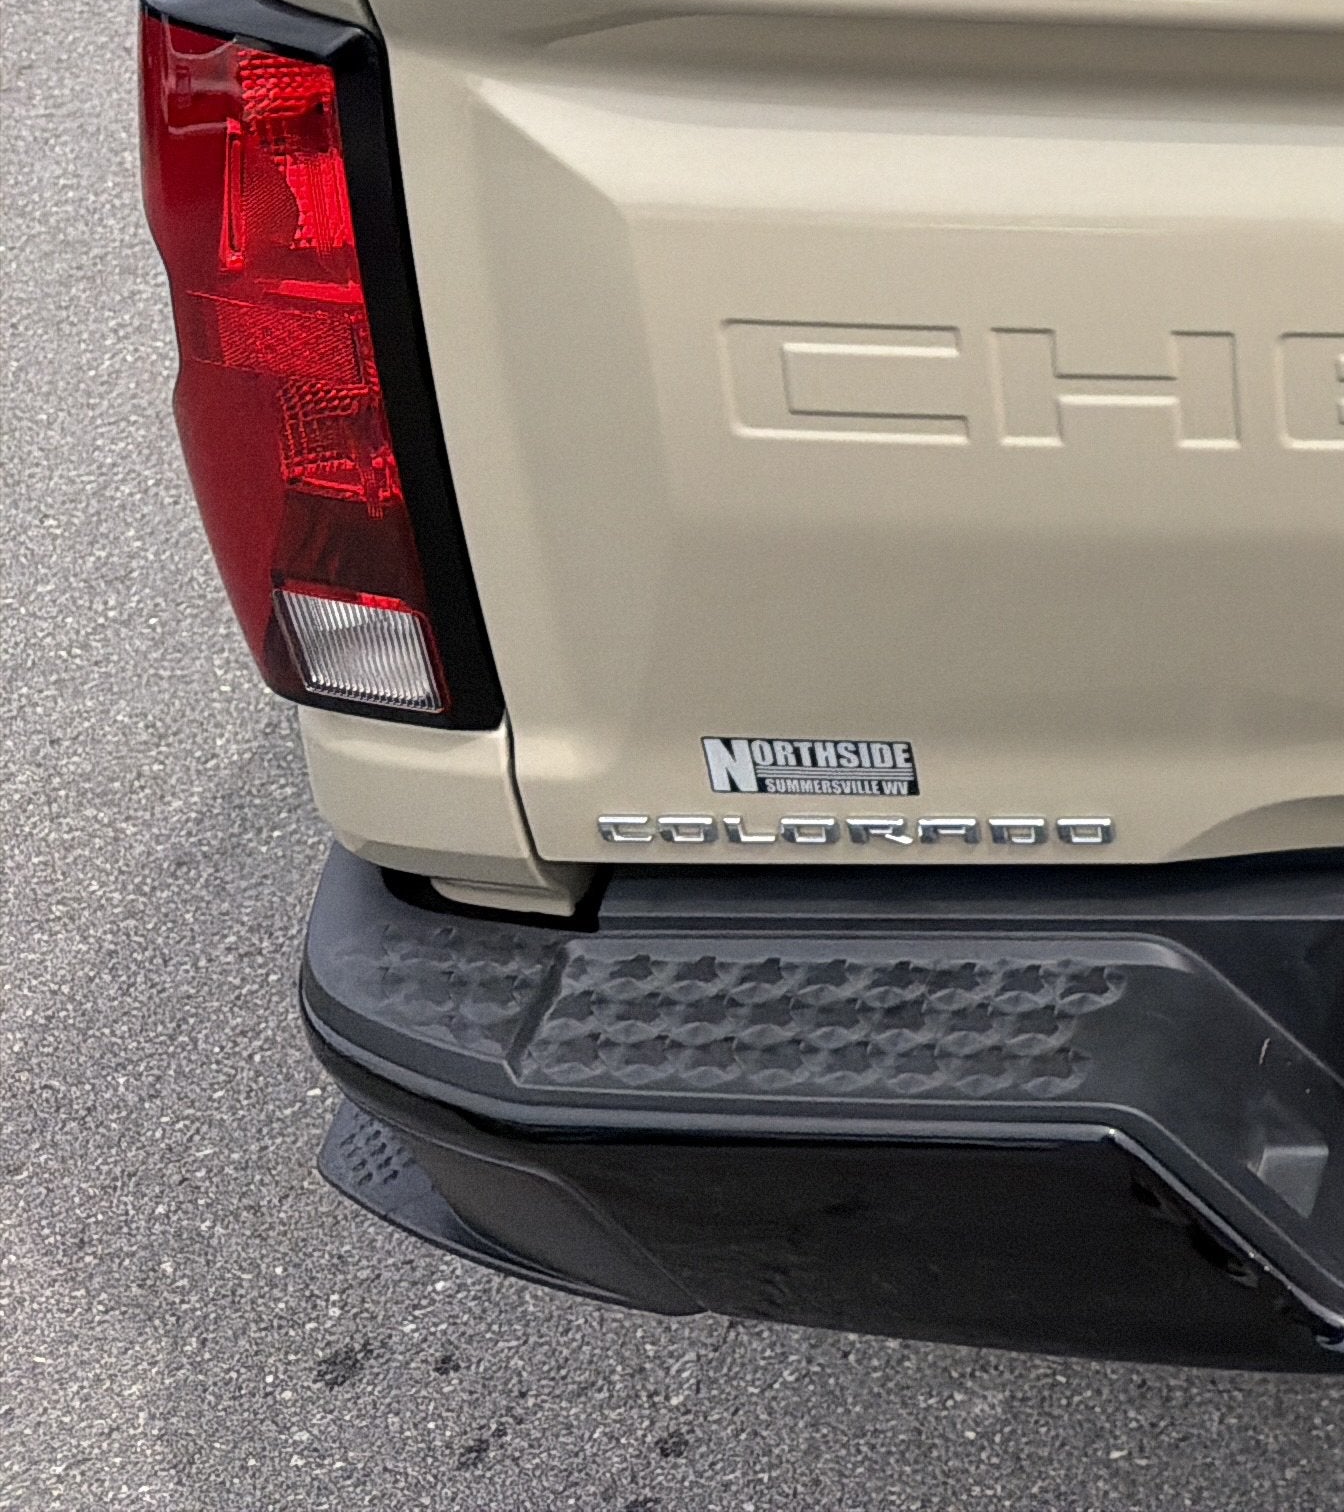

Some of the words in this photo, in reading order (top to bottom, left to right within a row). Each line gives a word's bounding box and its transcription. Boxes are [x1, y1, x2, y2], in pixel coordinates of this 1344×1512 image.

[703, 738, 914, 792] NORTHSIDE
[764, 778, 881, 795] SUMMERSVILLE
[882, 781, 909, 796] WV
[597, 815, 1117, 846] COLORADO
